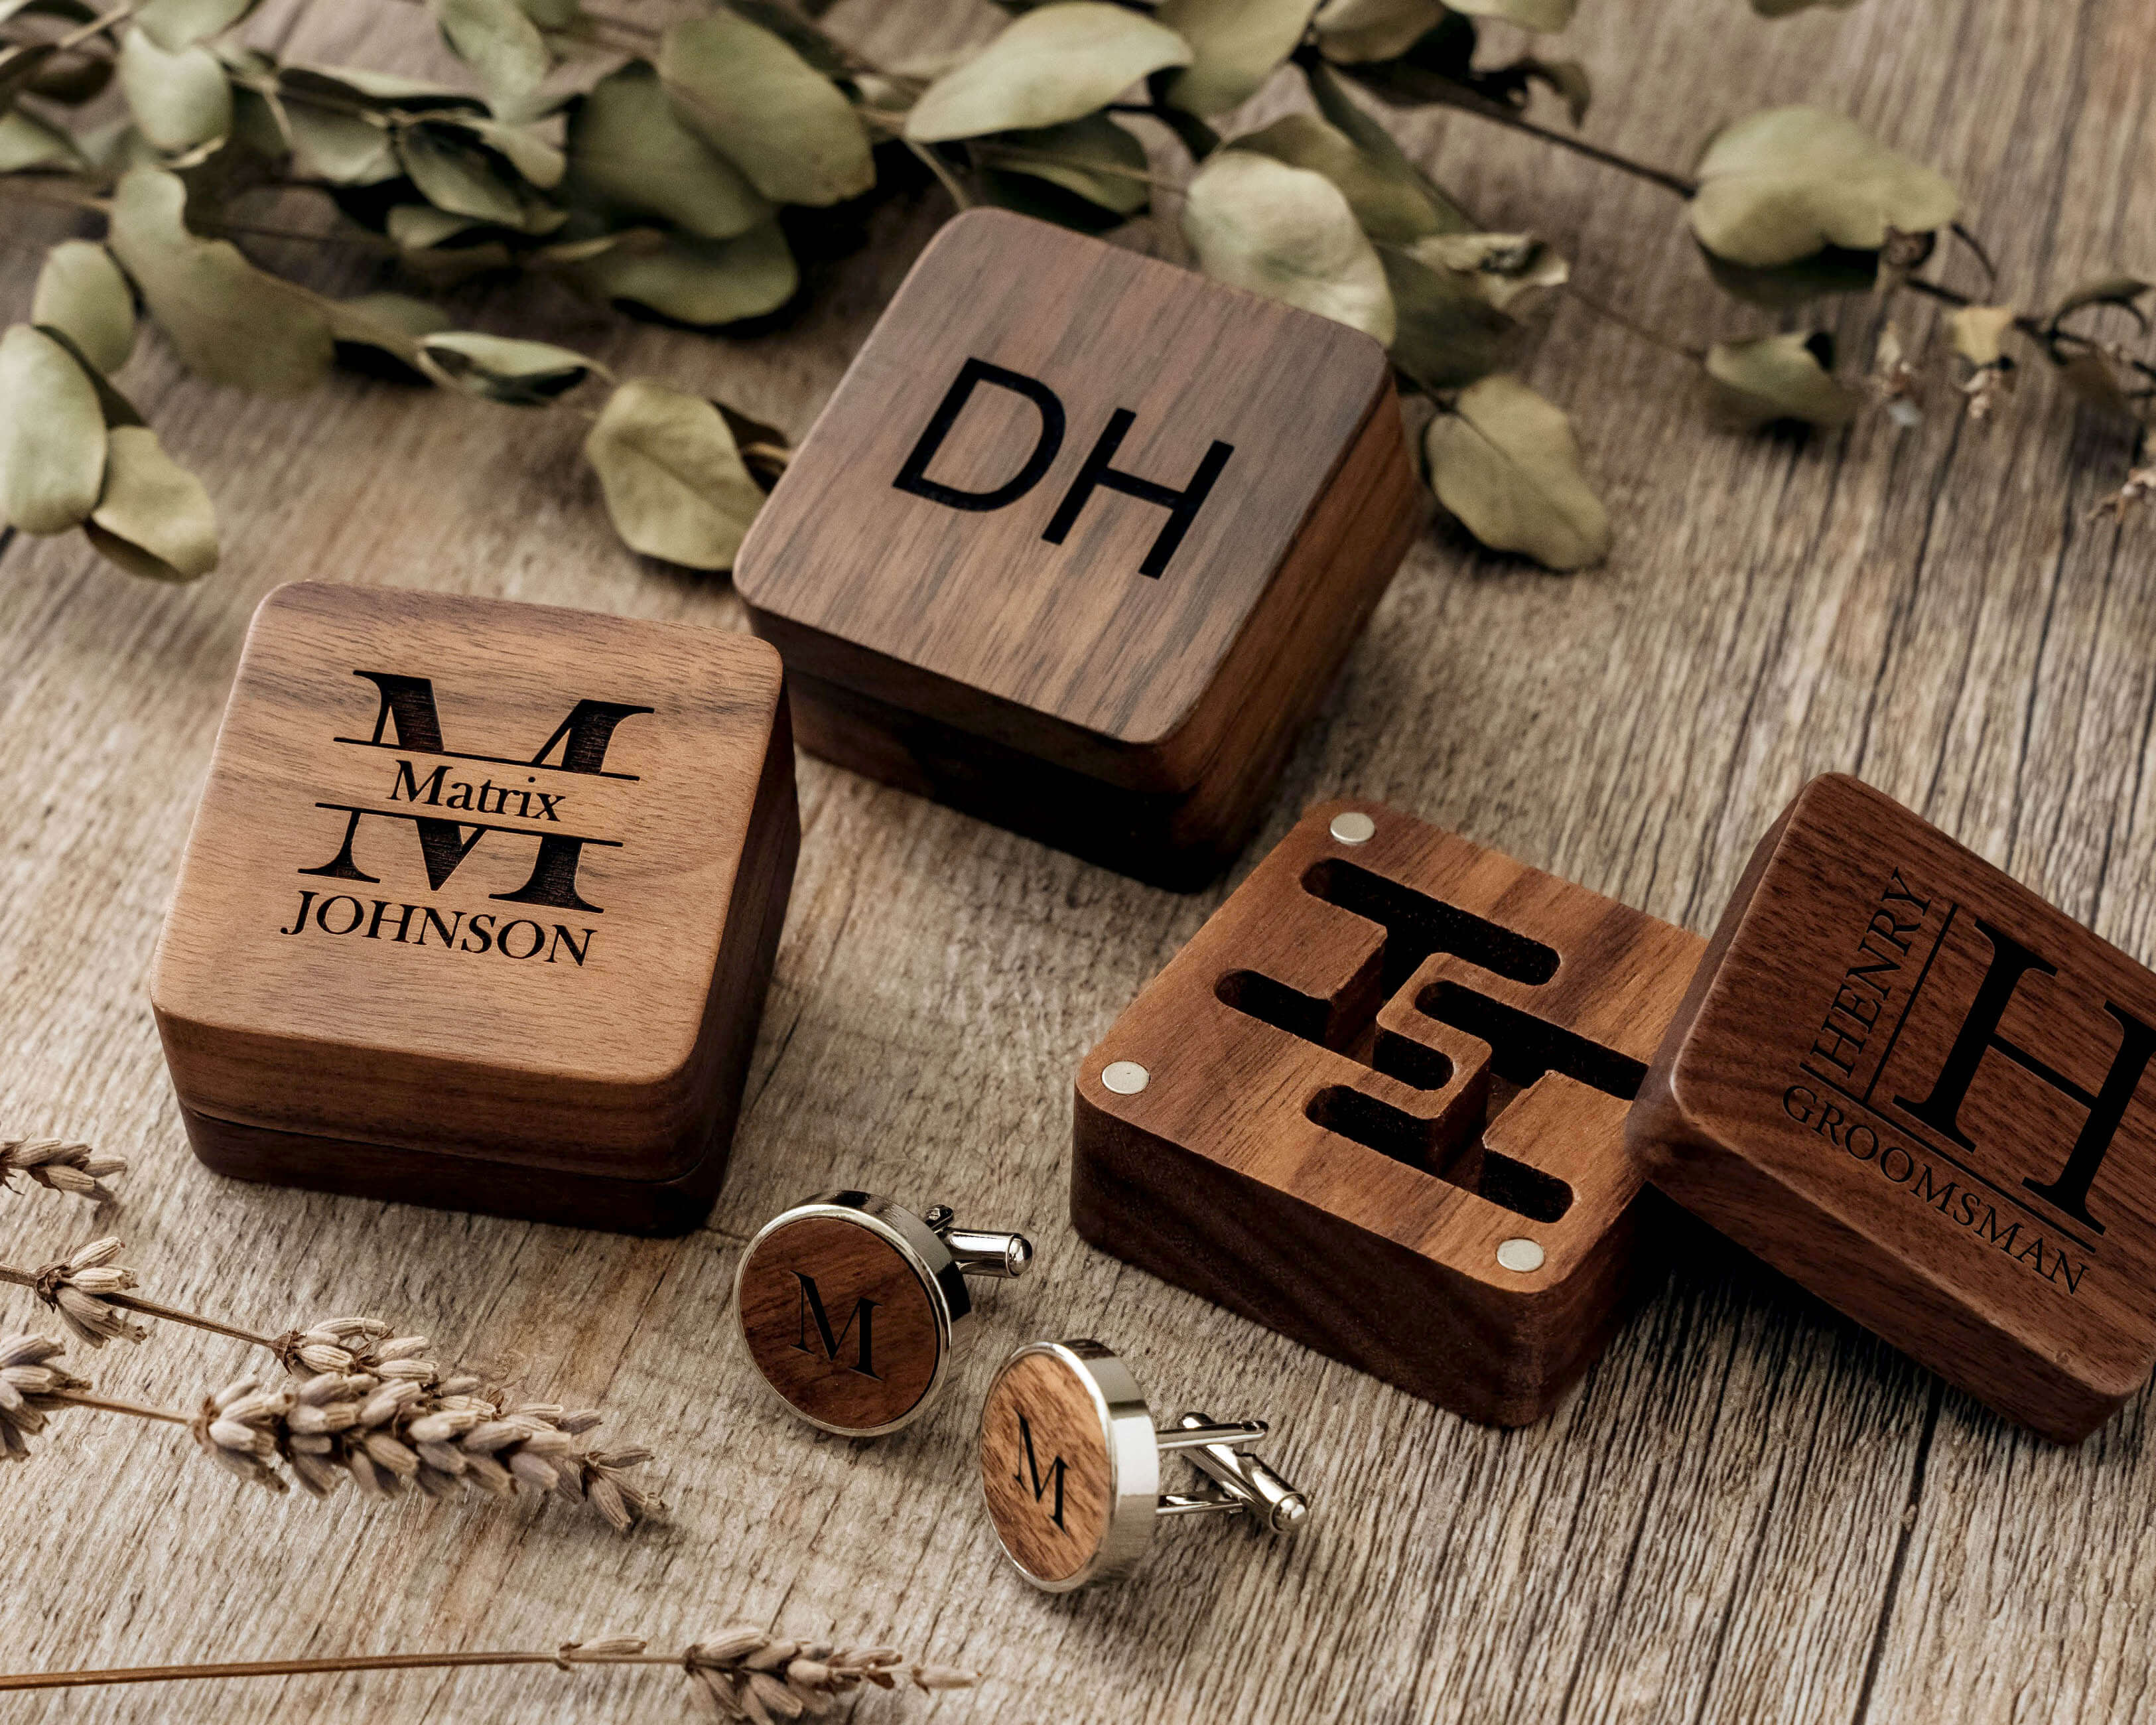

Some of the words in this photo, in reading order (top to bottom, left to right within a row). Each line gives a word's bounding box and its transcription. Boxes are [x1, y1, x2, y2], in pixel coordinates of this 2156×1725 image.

[892, 356, 1235, 580] DH
[386, 759, 566, 822] Matrix
[280, 890, 598, 967] JOHNSON
[1809, 866, 1931, 1079] HENRY
[1892, 918, 2156, 1237] H
[1782, 1084, 2090, 1295] GROOMSMAN
[789, 1269, 883, 1381] M
[1013, 1407, 1069, 1535] M
